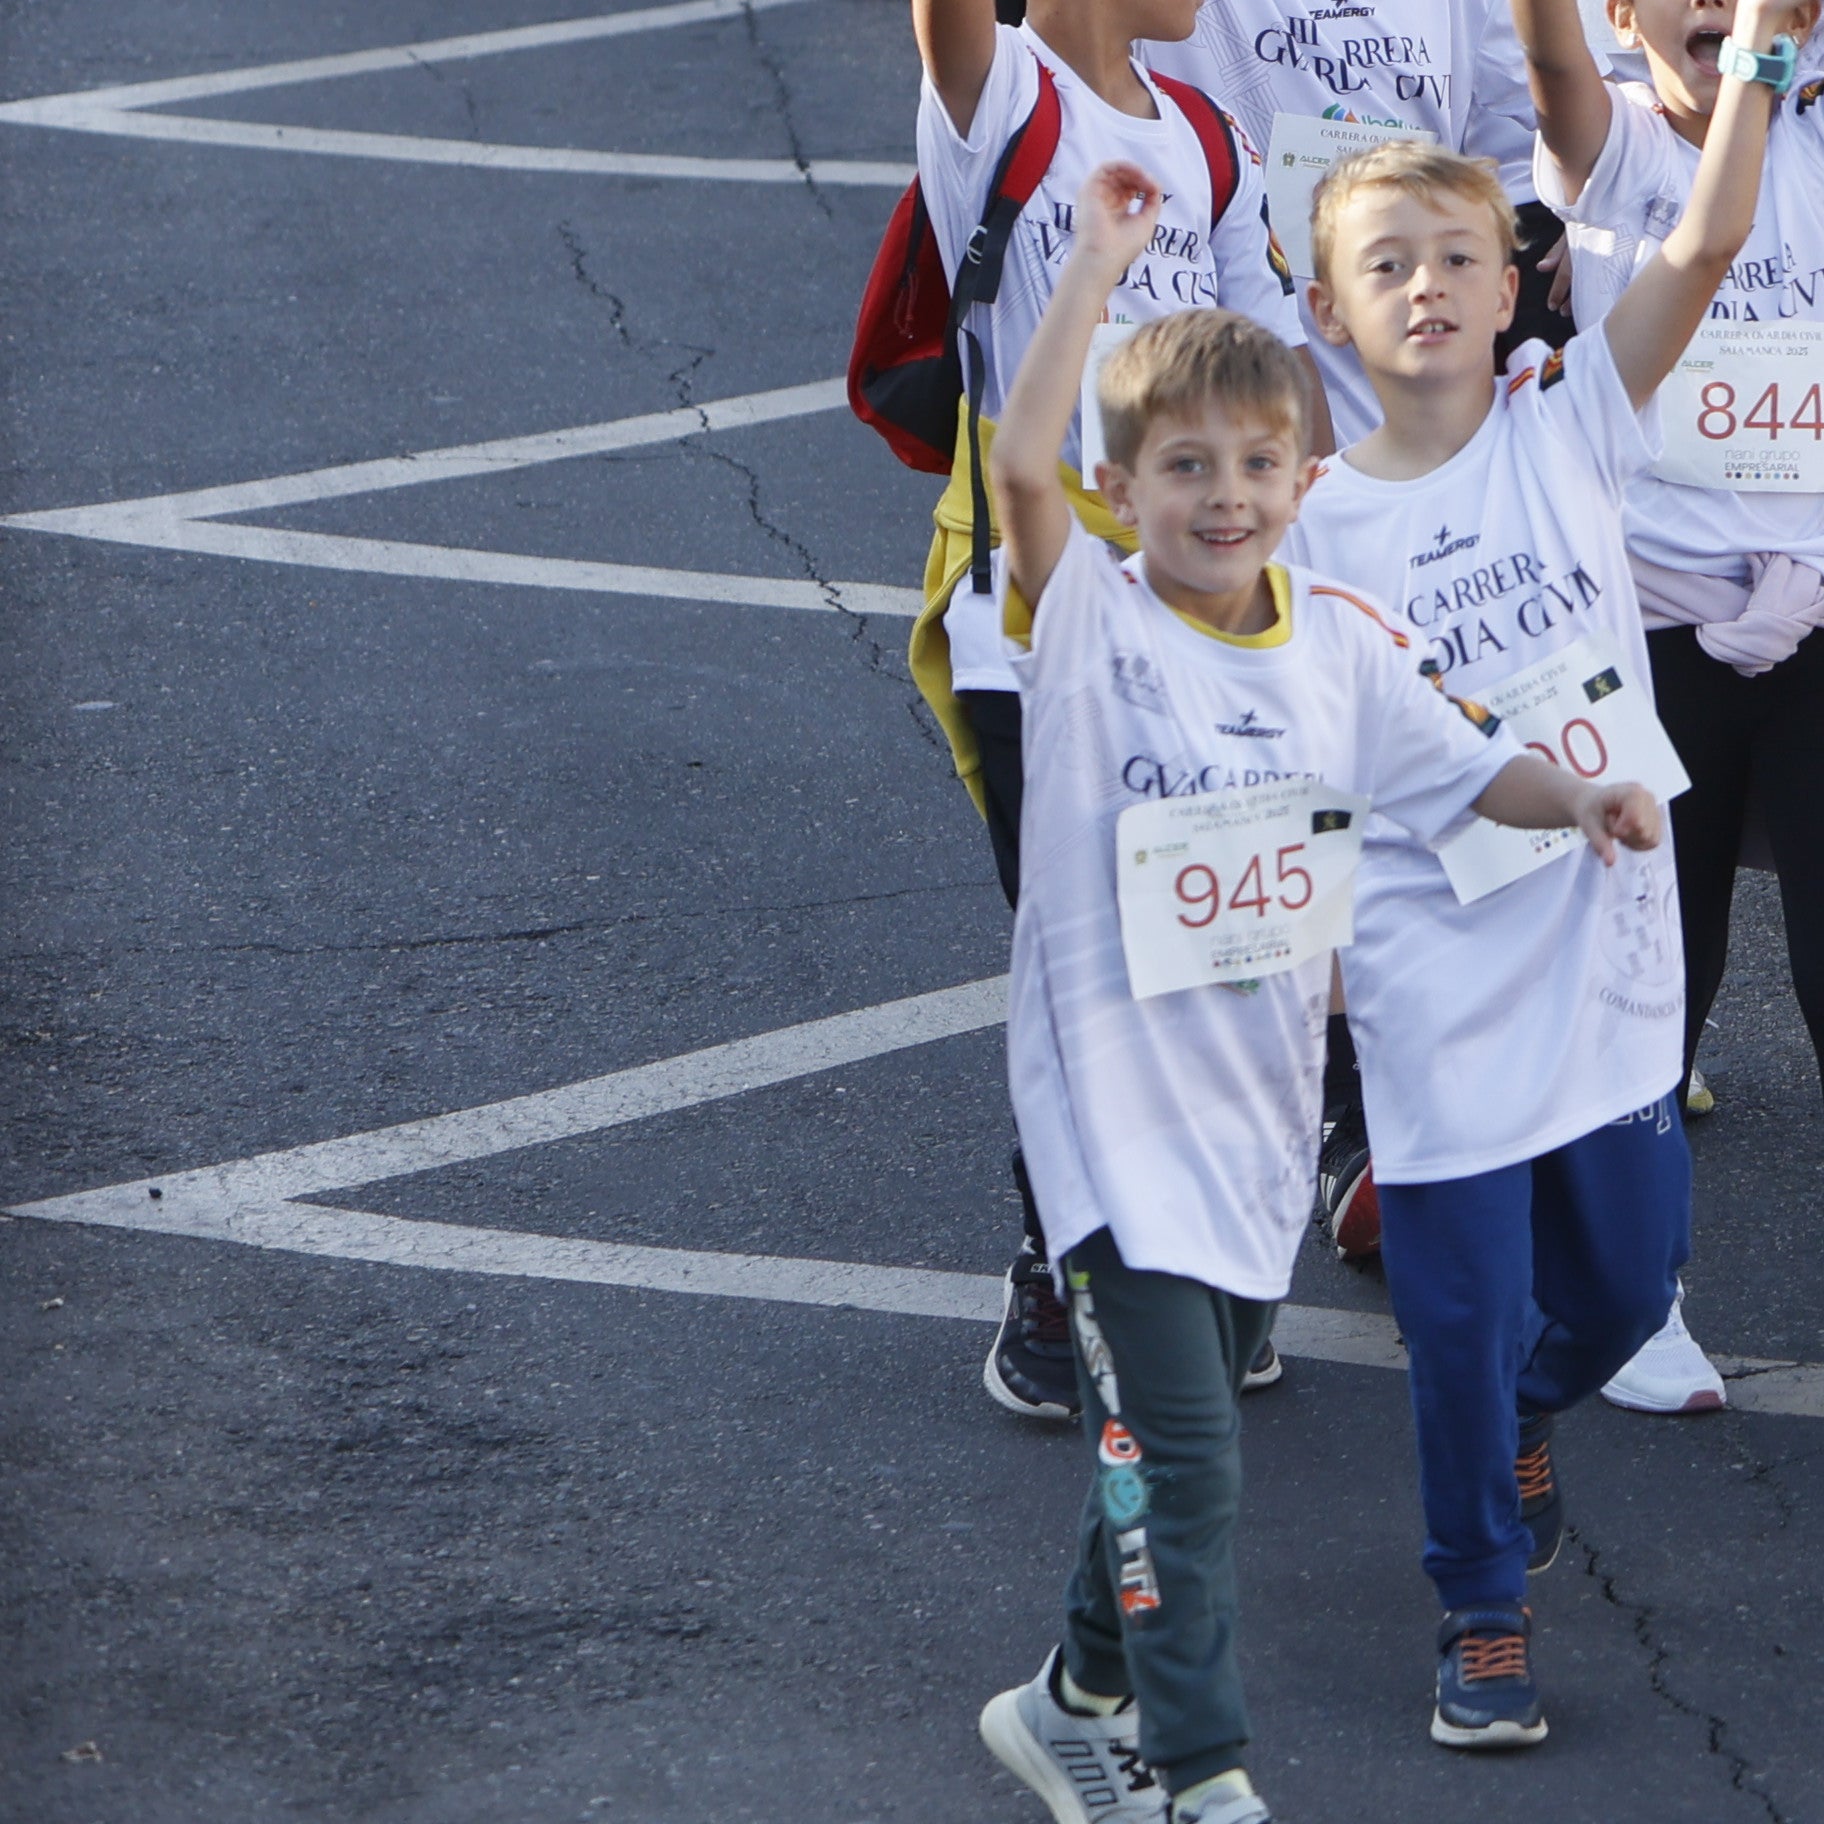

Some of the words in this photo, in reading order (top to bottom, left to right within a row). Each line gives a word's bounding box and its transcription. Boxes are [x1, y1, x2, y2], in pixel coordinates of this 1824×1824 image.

[1308, 6, 1375, 19] TEAMERGY
[1786, 346, 1809, 356] 2025
[1724, 449, 1755, 461] nani
[1759, 449, 1800, 466] grupo
[1724, 461, 1799, 472] EMPRESARIAL
[1409, 534, 1480, 569] TEAMERGY
[1174, 843, 1313, 929] 945
